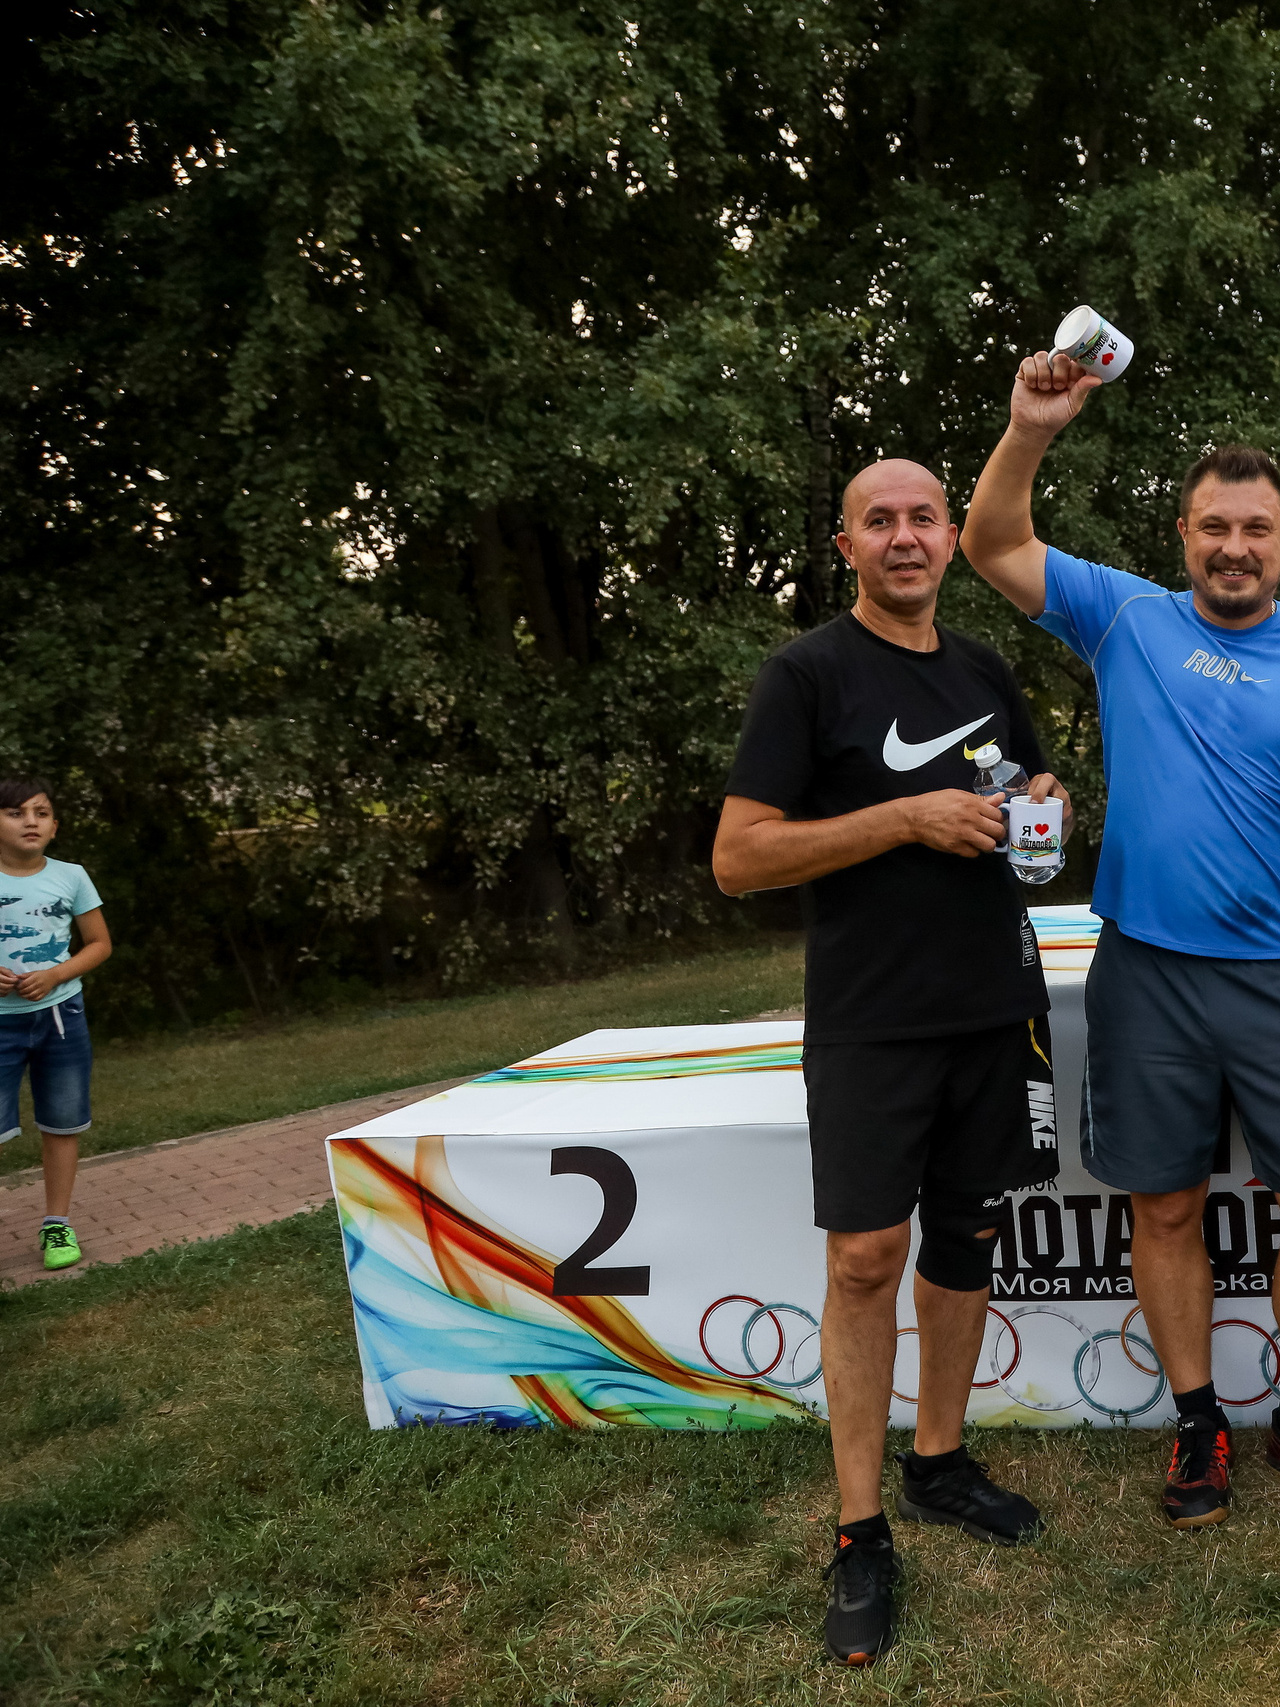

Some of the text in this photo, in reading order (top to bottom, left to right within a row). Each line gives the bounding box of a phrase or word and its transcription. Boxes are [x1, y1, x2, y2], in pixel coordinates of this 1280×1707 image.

[1182, 648, 1241, 685] RUN
[1022, 825, 1032, 837] Я
[1026, 1079, 1057, 1150] NIKE
[550, 1146, 651, 1296] 2
[991, 1272, 1071, 1296] Моя
